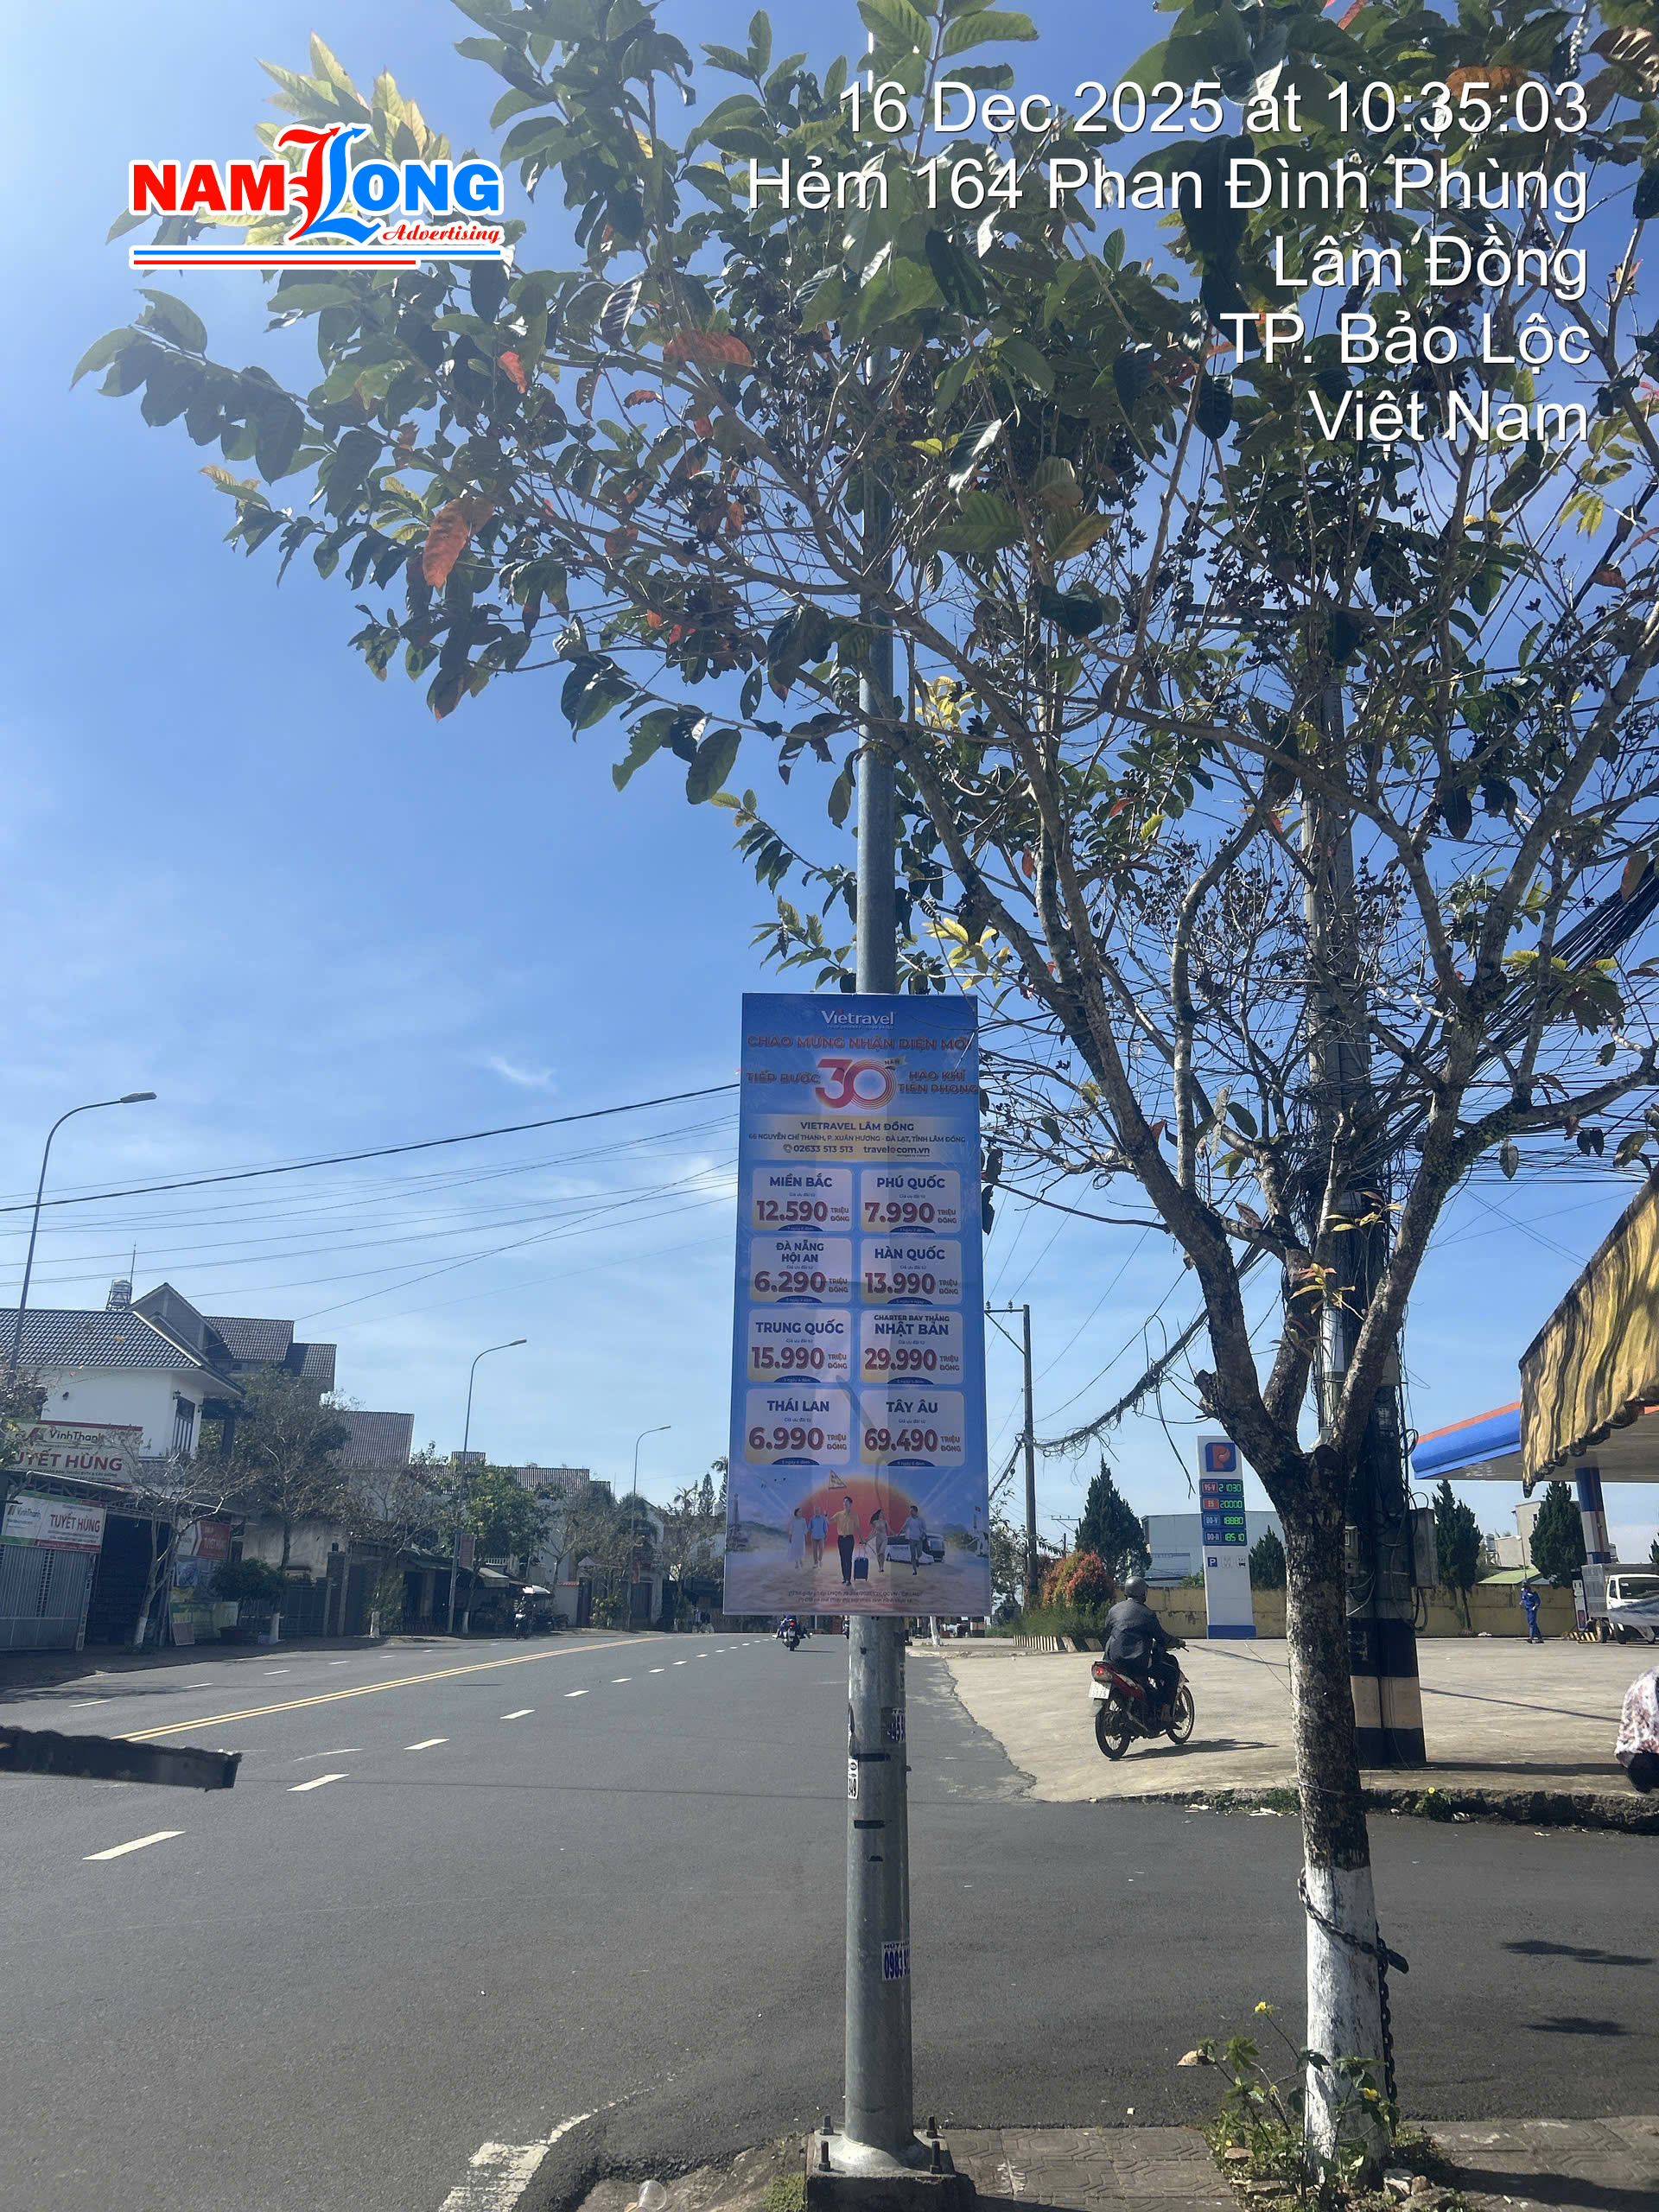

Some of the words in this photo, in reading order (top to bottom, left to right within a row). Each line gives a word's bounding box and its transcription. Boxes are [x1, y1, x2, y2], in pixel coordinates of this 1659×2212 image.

[821, 1009, 894, 1025] Vietravel
[815, 1058, 896, 1109] 30
[800, 1122, 856, 1131] VIETRAVEL
[859, 1121, 880, 1131] LÂM
[884, 1121, 914, 1131] ĐỒNG
[770, 1174, 804, 1187] MIỀN
[805, 1173, 832, 1187] BẮC
[877, 1175, 904, 1188] PHÚ
[907, 1174, 945, 1190] QUỐC
[756, 1200, 828, 1222] 12.590
[864, 1202, 935, 1223] 7.990
[776, 1240, 792, 1251] ĐÀ
[795, 1239, 824, 1251] NẴNG
[874, 1246, 903, 1259] HÀN
[906, 1246, 945, 1261] QUỐC
[782, 1252, 801, 1264] HỘI
[803, 1254, 818, 1262] AN
[754, 1271, 827, 1293] 6.290
[864, 1272, 936, 1294] 13.990
[756, 1322, 801, 1333] TRUNG
[805, 1319, 844, 1335] QUỐC
[875, 1321, 914, 1337] NHẬT
[918, 1322, 949, 1335] BẢN
[752, 1347, 824, 1369] 15.990
[864, 1348, 937, 1371] 29.990
[767, 1398, 799, 1411] THÁI
[803, 1401, 829, 1412] LAN
[886, 1399, 913, 1413] TÂY
[917, 1399, 938, 1413] ÂU
[749, 1427, 824, 1450] 6.990
[864, 1428, 939, 1452] 69.490
[12, 1448, 61, 1467] UYẾT
[65, 1452, 122, 1471] HÙNG
[51, 1511, 76, 1529] TUYẾT
[77, 1516, 100, 1533] HÙNG
